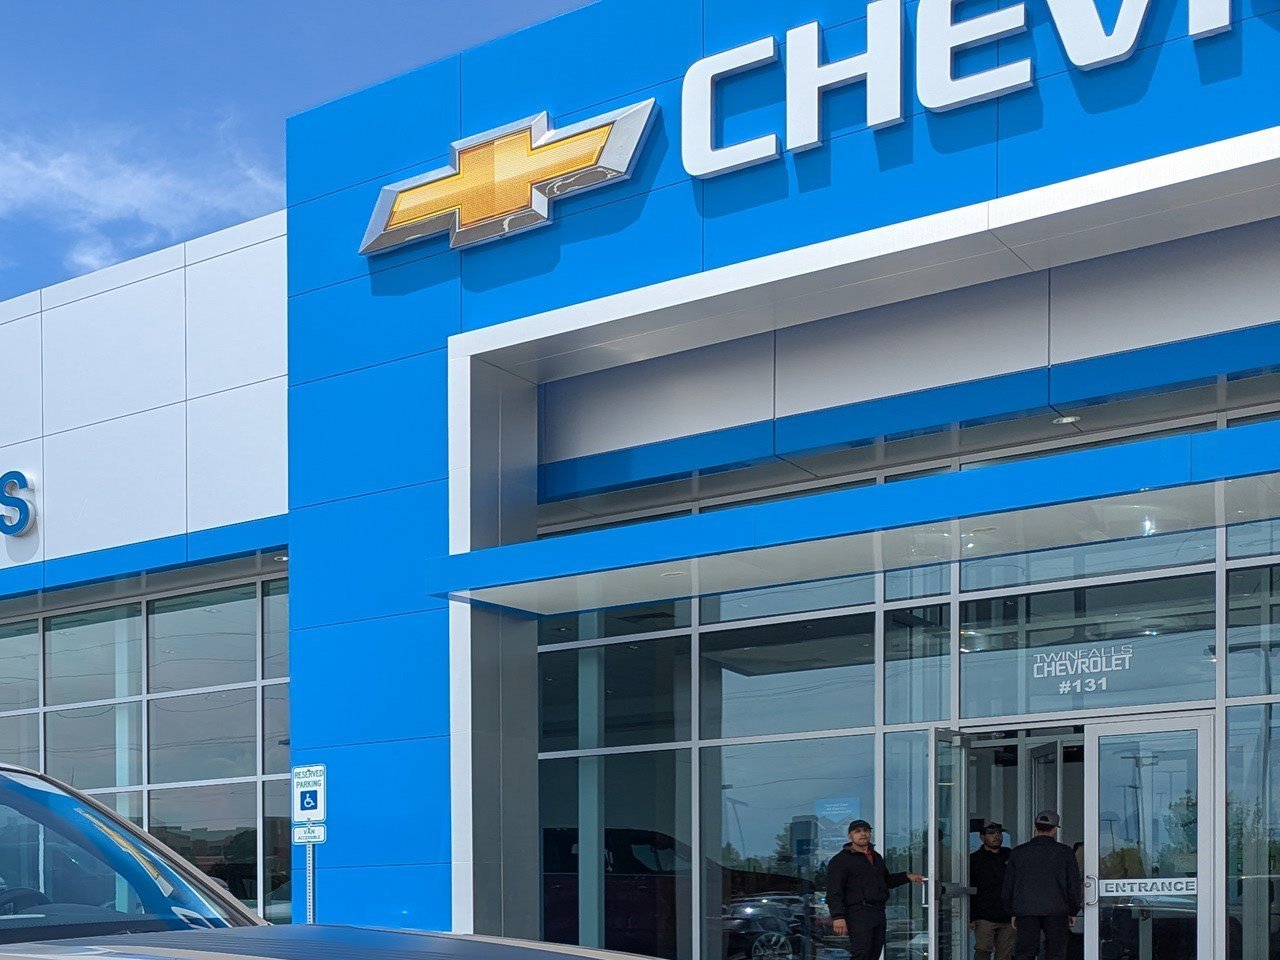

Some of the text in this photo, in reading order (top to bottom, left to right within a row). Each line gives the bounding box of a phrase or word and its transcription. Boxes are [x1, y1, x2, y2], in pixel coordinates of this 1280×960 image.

[682, 0, 1232, 180] CHEV
[1033, 644, 1133, 663] TWINFALLS
[1033, 654, 1133, 678] CHEVROLET
[1058, 677, 1108, 694] #131
[294, 769, 324, 780] RESERVED
[296, 780, 322, 789] PARKING
[1104, 880, 1196, 893] ENTRANCE
